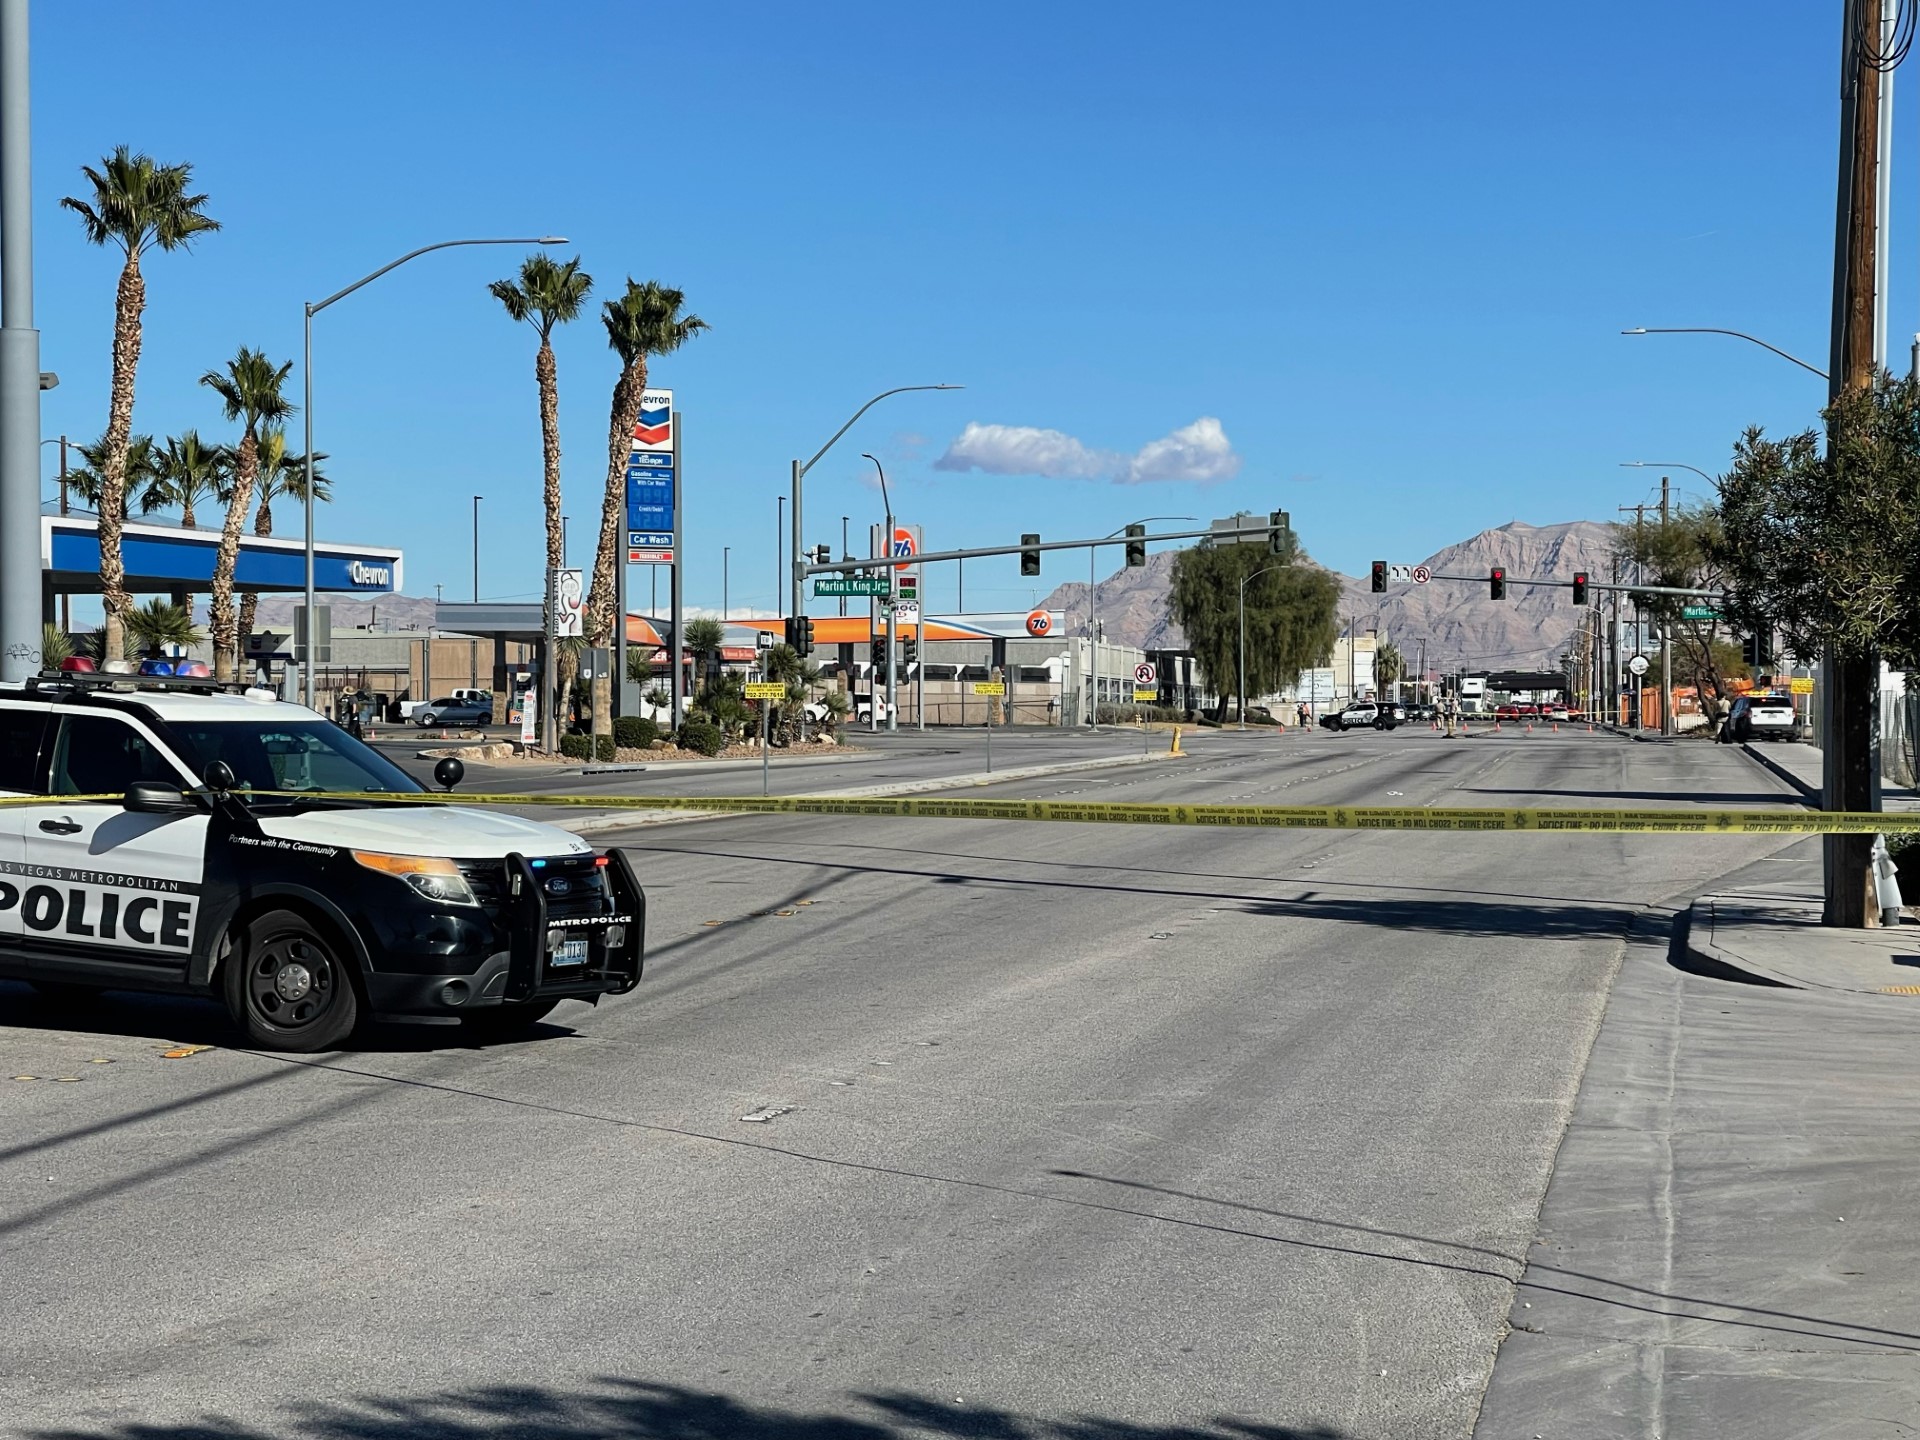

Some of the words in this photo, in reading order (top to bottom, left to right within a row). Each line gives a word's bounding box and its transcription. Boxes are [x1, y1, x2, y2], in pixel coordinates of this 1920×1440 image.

[642, 395, 670, 404] evron
[648, 536, 669, 544] Wash
[352, 560, 389, 585] Chevron
[820, 580, 844, 592] Martin
[846, 581, 851, 592] L
[852, 580, 870, 594] King
[872, 580, 881, 592] Jr
[1687, 606, 1706, 616] Martin
[1033, 618, 1048, 628] 76
[229, 834, 259, 846] Partners
[261, 839, 276, 848] with
[278, 841, 290, 849] the
[293, 842, 338, 857] Community
[19, 865, 62, 879] VEGAS
[69, 872, 178, 891] METROPOLITAN
[552, 880, 568, 890] Ford
[549, 919, 589, 927] METRO
[591, 916, 632, 924] POLICE
